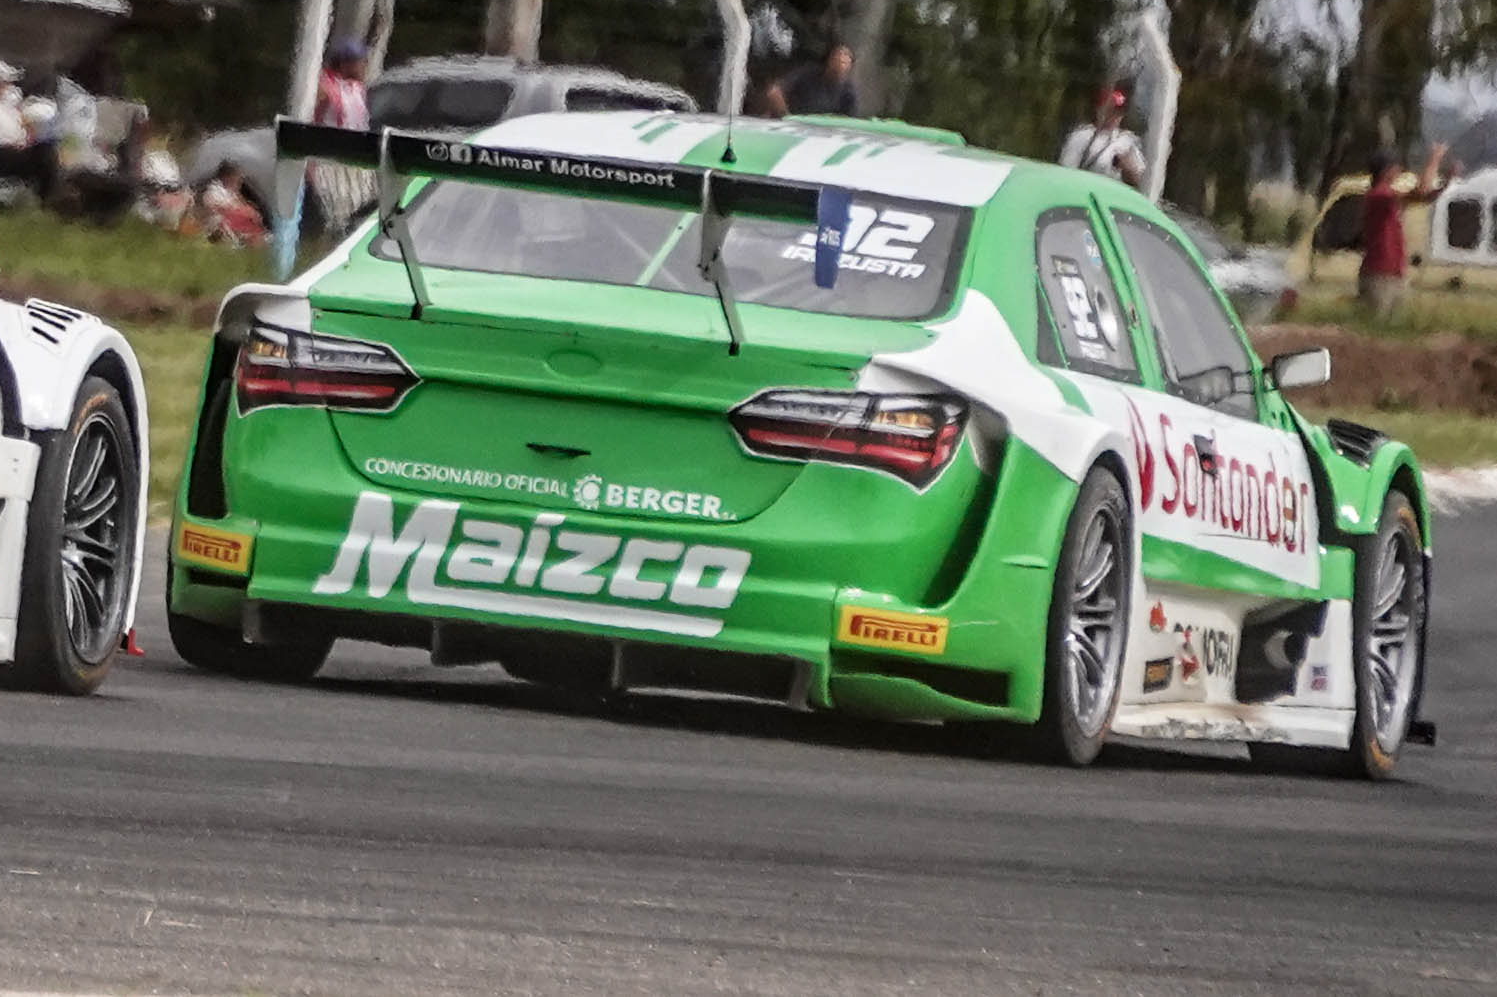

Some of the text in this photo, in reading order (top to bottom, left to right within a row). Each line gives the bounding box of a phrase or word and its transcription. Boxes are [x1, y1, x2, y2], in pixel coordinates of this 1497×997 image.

[550, 158, 676, 189] Motorsport
[365, 458, 721, 519] CONCESIONARIO OFICIAL BERGER
[1160, 413, 1309, 554] Santander
[312, 491, 752, 608] Maizco
[850, 615, 938, 647] PIRELLI
